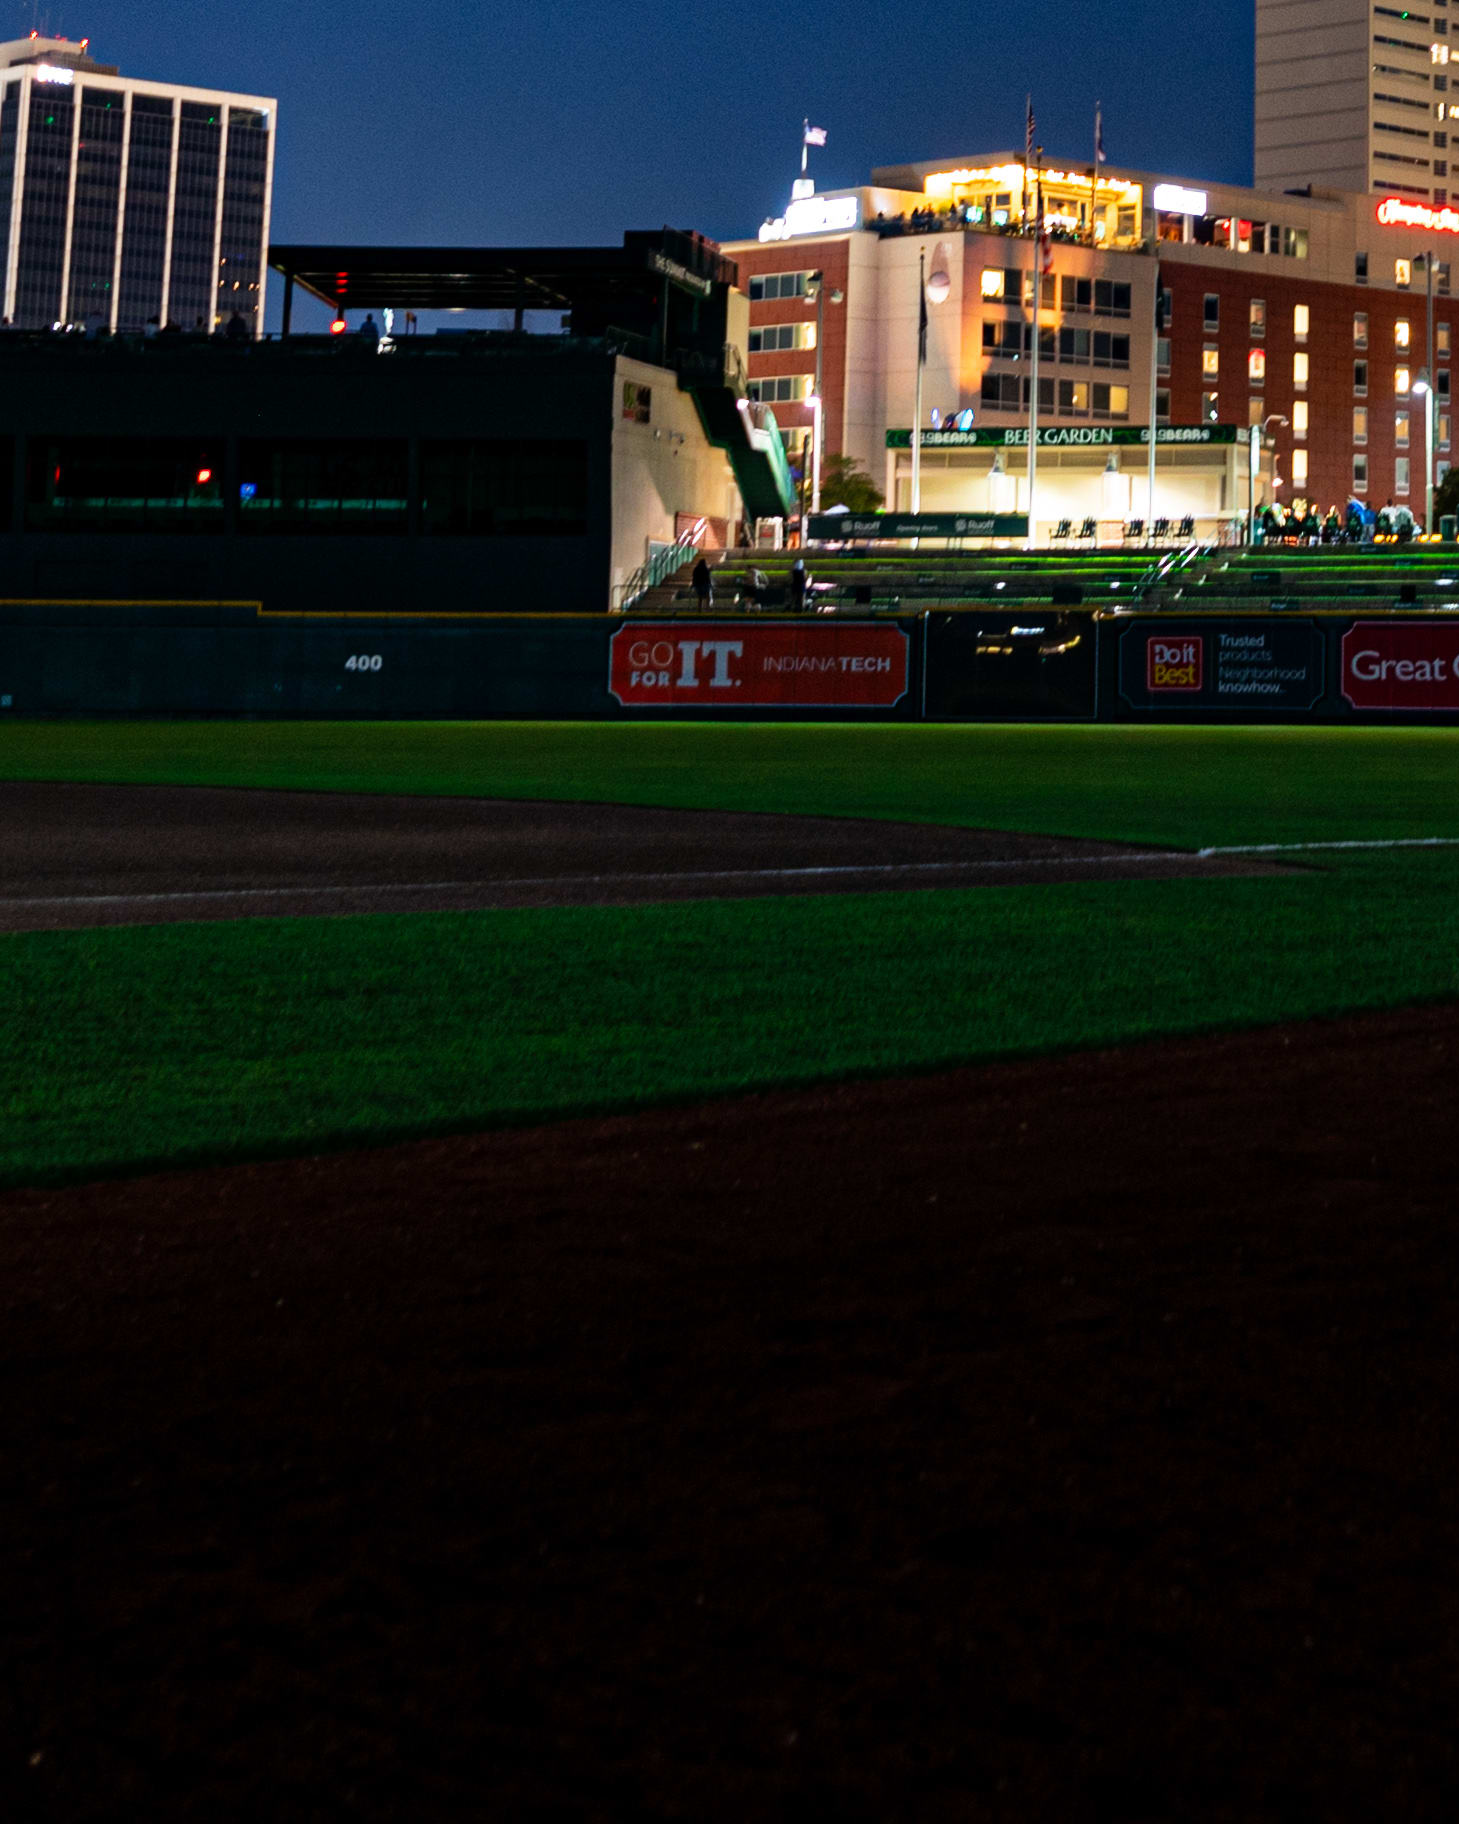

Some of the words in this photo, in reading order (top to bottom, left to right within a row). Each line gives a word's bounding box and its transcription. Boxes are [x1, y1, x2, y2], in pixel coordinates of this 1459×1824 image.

[1044, 428, 1113, 444] GARDEN
[853, 520, 881, 530] Ruoff
[967, 519, 996, 530] Ruoff
[1218, 633, 1265, 647] Trusted
[628, 640, 674, 668] GO
[1218, 648, 1273, 662] products
[344, 653, 384, 673] 400
[675, 640, 744, 688] IT.
[1350, 649, 1448, 682] Great
[629, 671, 670, 687] FOR
[1154, 664, 1197, 686] Best
[1218, 666, 1306, 681] Neighborhood
